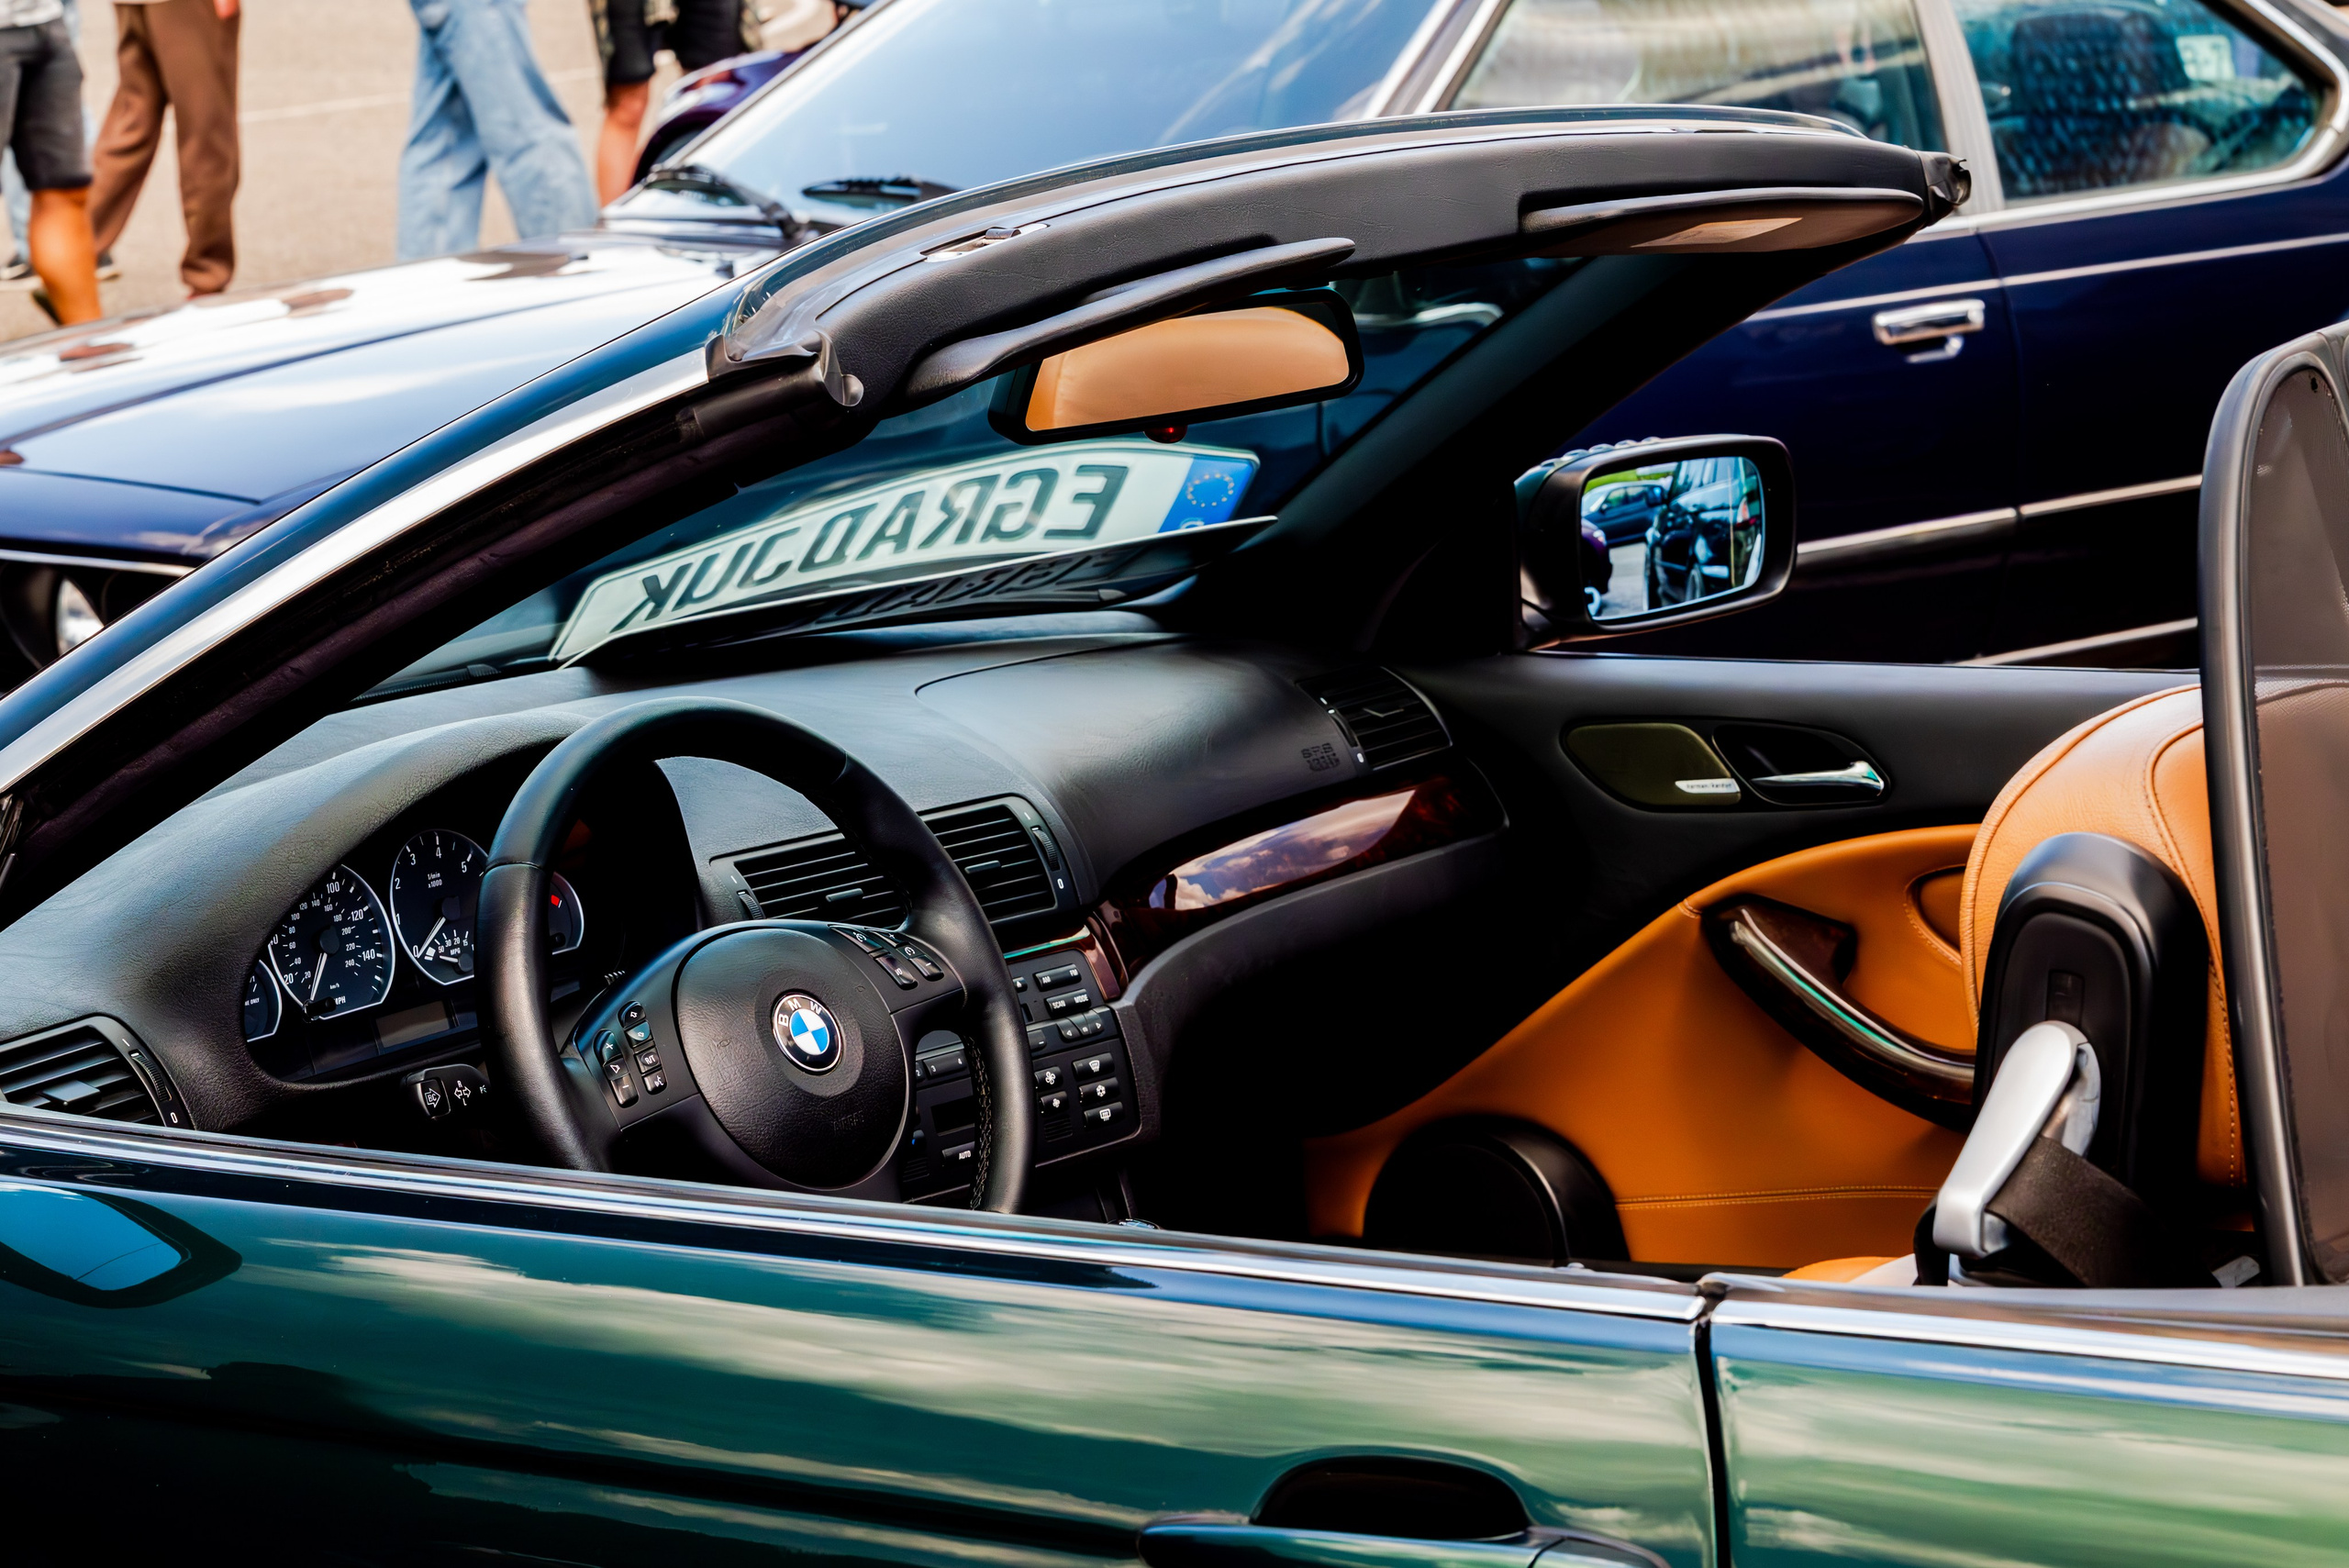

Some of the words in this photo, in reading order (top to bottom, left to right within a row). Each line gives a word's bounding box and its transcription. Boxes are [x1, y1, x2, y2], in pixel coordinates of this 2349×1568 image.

[436, 848, 442, 858] 4
[410, 853, 416, 865] 3
[462, 862, 467, 873] 5
[327, 882, 340, 894] 100
[395, 878, 400, 889] 2
[299, 902, 307, 910] 120
[351, 910, 363, 921] 120
[396, 914, 400, 925] 1
[362, 950, 374, 961] 140
[413, 945, 418, 957] 0
[345, 959, 355, 967] 240
[284, 973, 294, 984] 20
[1052, 1000, 1065, 1009] SCAN
[1074, 994, 1088, 1003] MODE
[778, 998, 822, 1027] BMW
[428, 1094, 437, 1103] BC
[959, 1151, 971, 1160] AUTO
